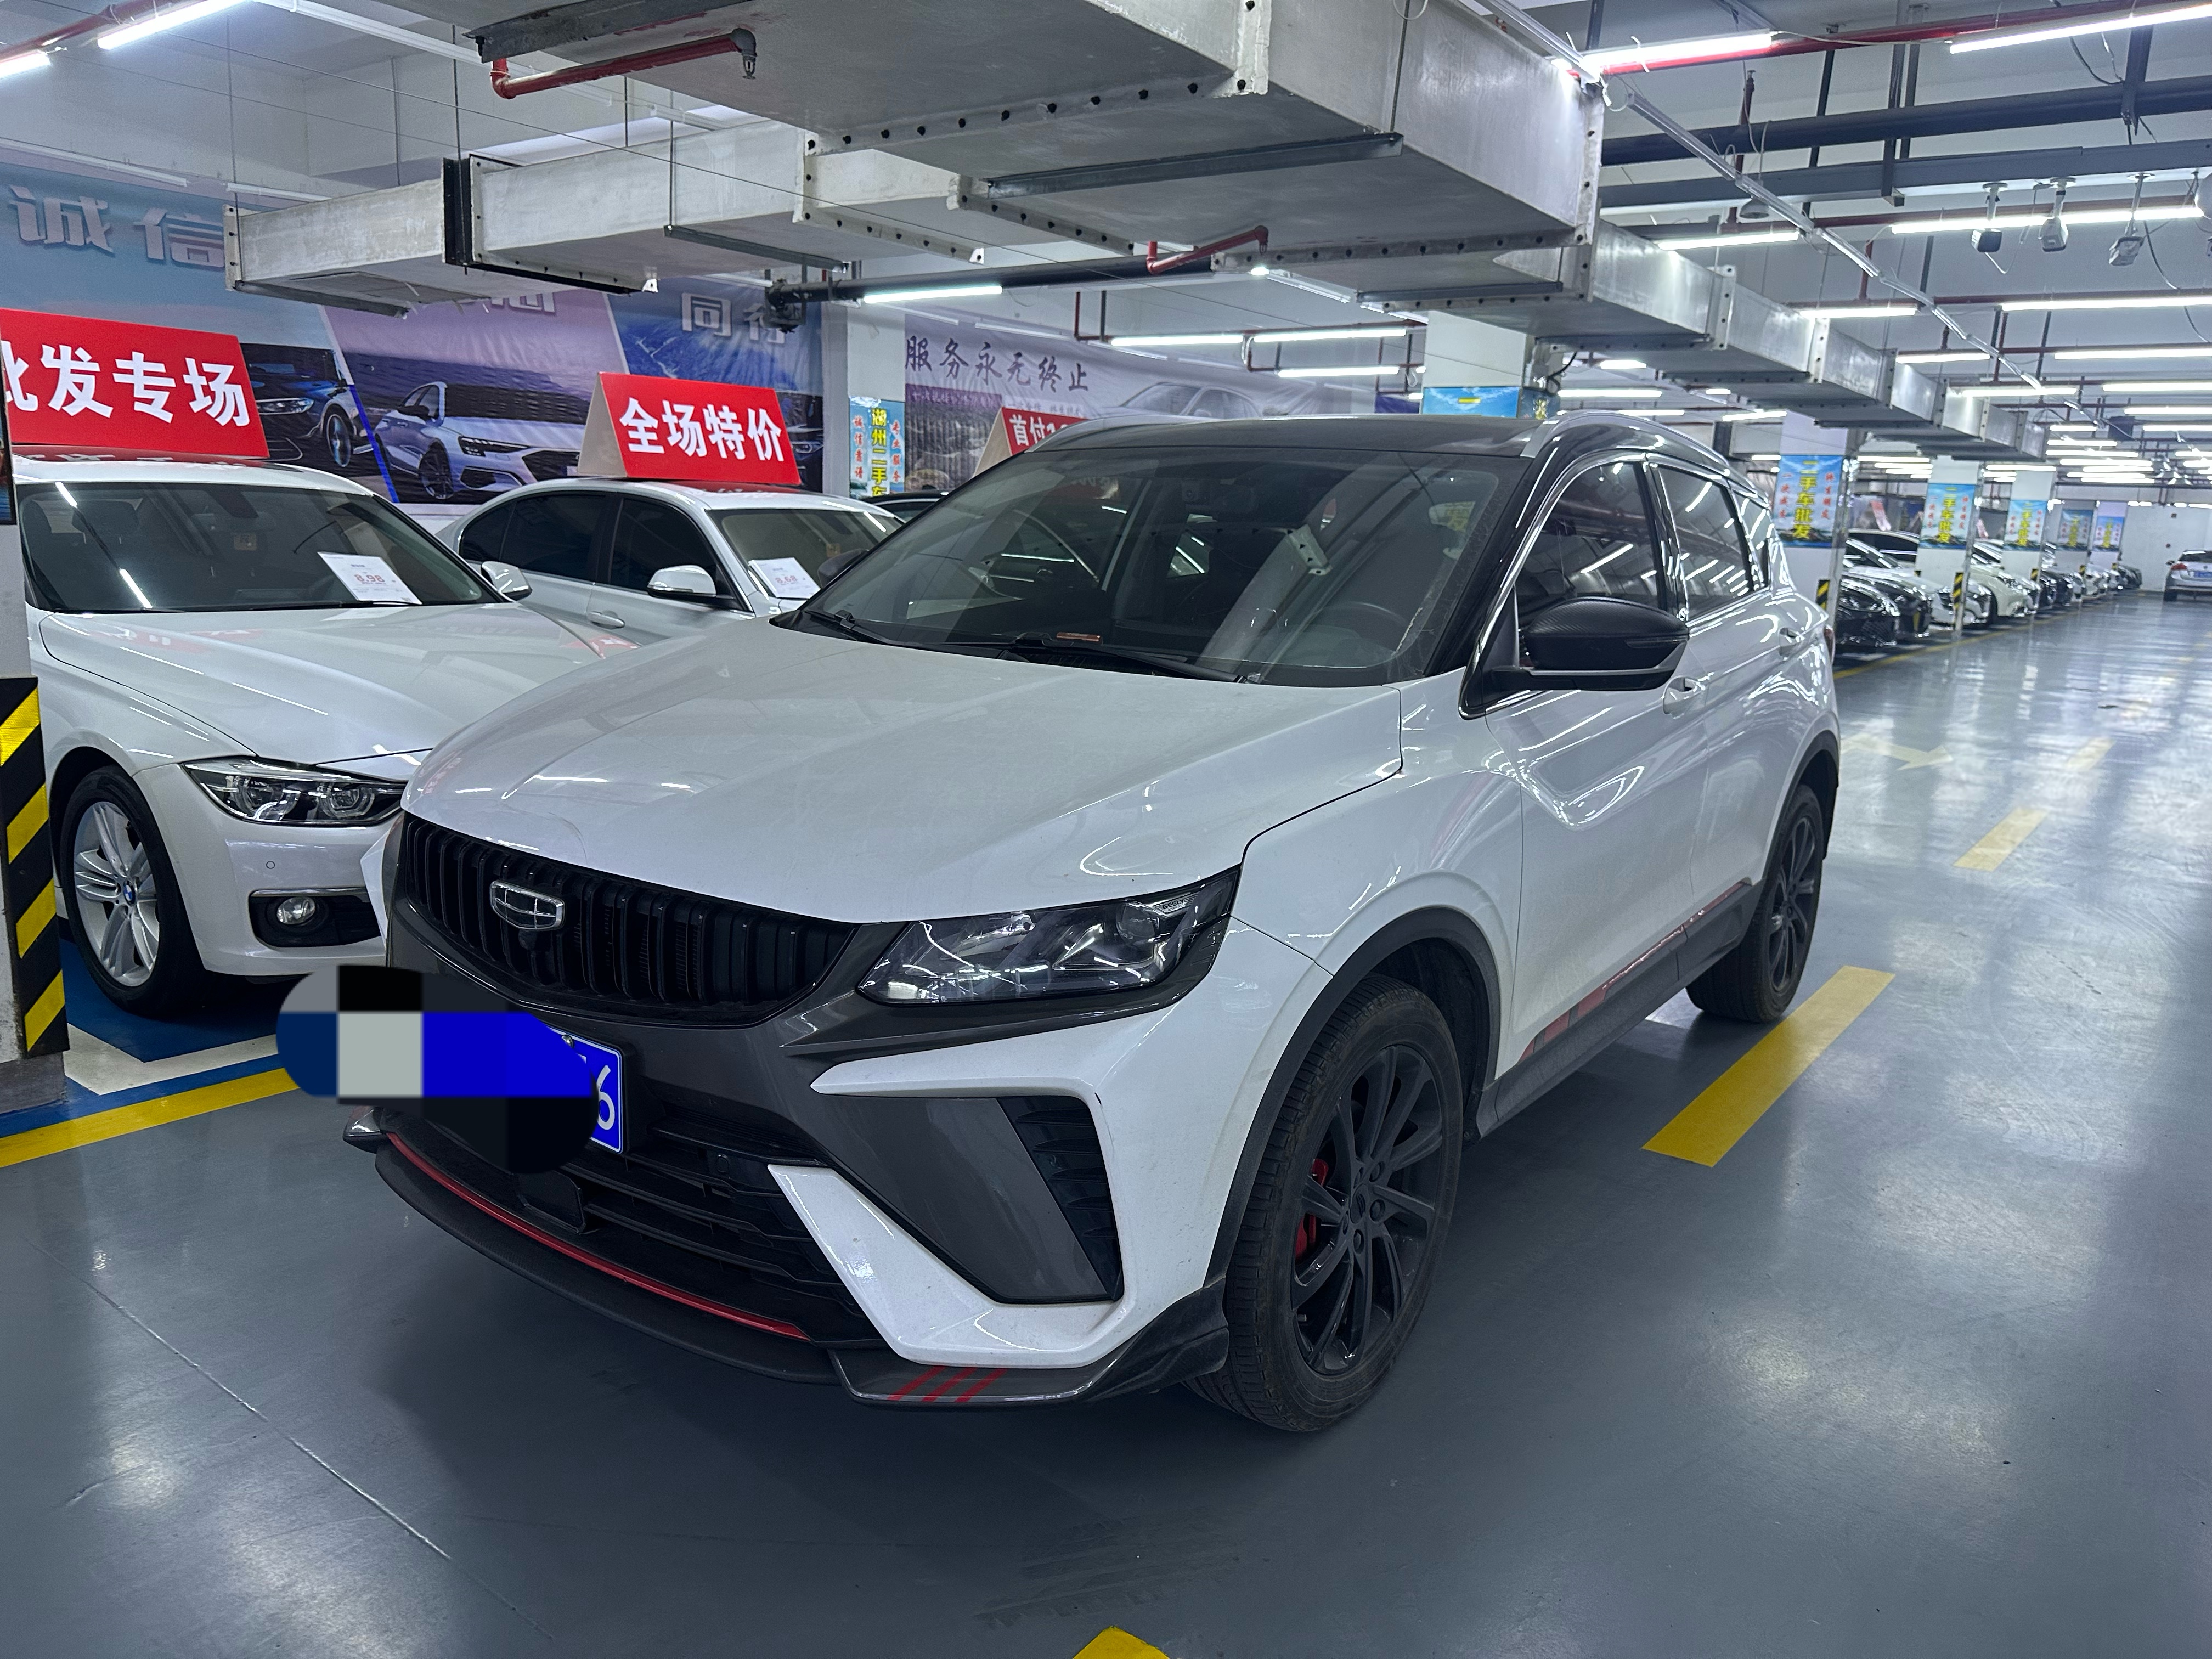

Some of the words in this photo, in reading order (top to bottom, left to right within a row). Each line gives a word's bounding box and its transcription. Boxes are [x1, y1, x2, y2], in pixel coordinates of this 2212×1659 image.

[8, 184, 225, 269] 诚信
[905, 335, 1088, 392] 服务永无终止
[619, 397, 784, 462] 全场特价
[1793, 460, 1819, 539] 二手车批发
[354, 574, 385, 583] 8.98
